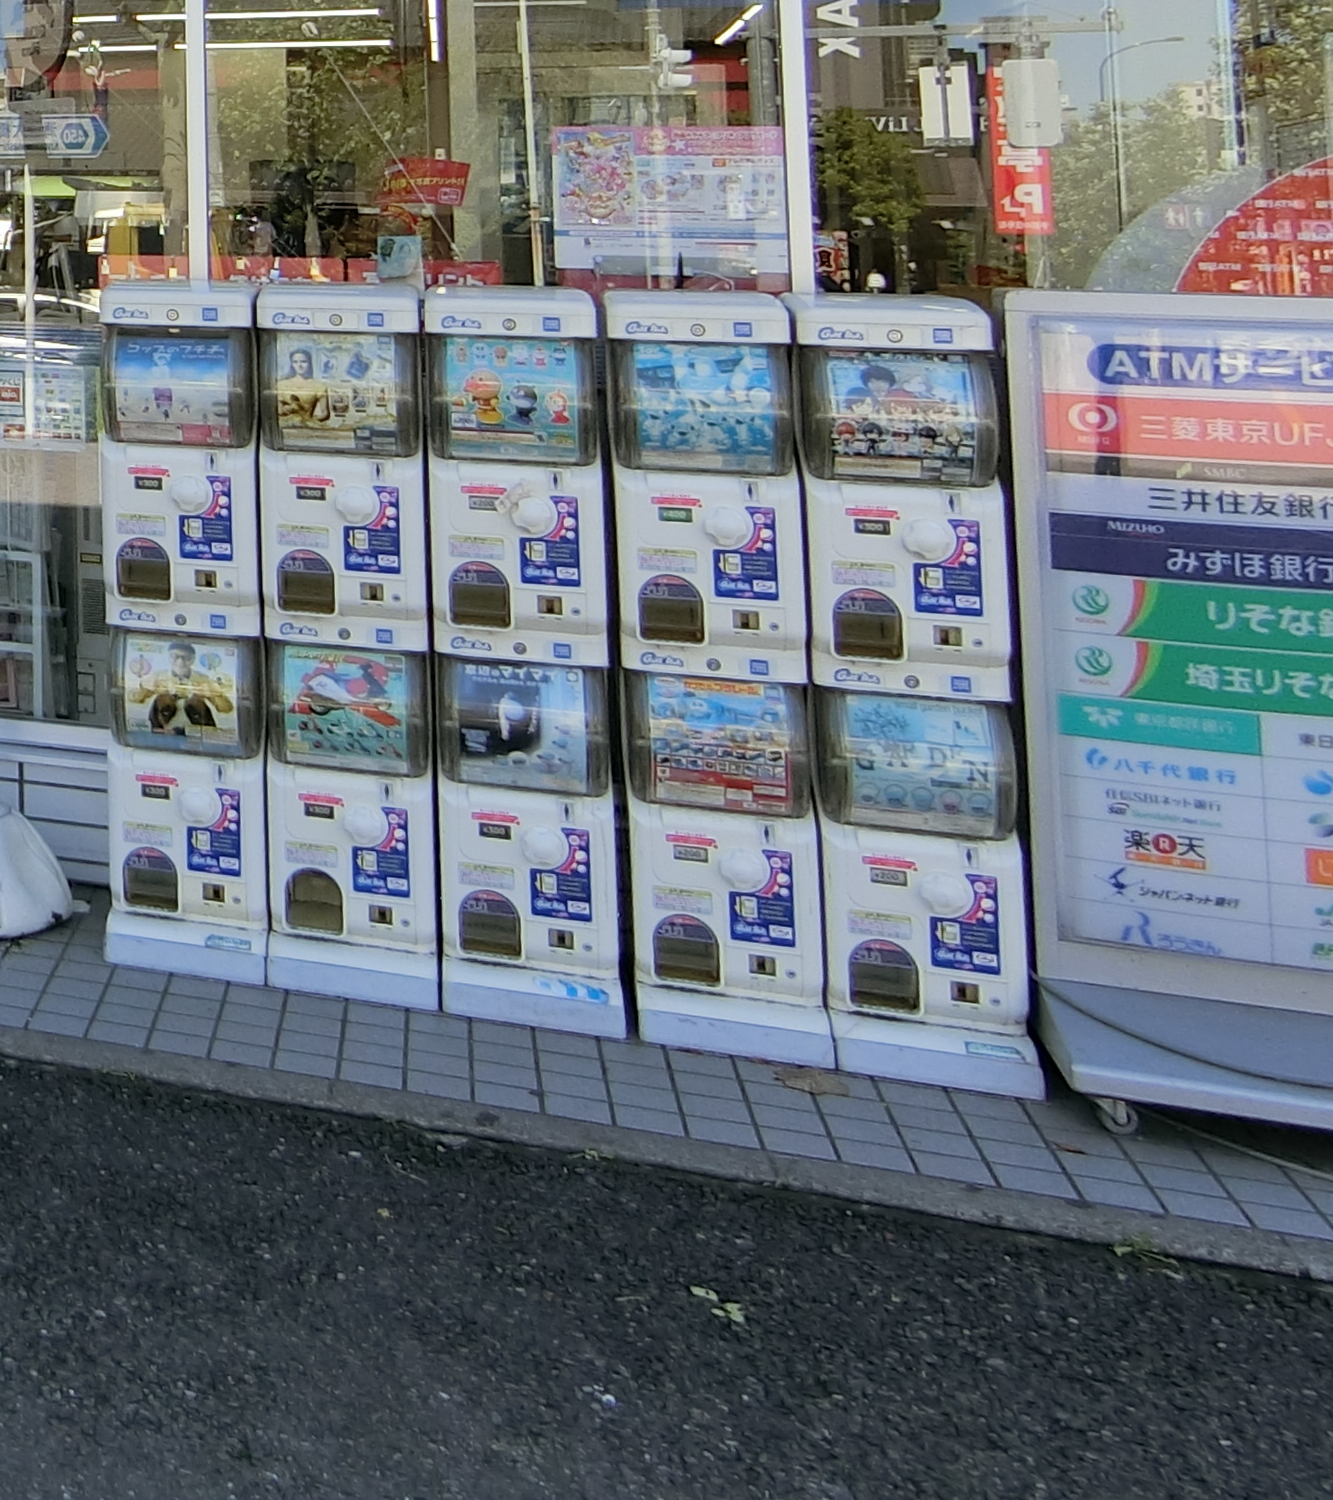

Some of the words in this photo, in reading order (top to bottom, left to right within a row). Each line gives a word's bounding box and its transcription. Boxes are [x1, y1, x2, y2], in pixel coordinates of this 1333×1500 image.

[126, 343, 226, 356] コップのフチ子
[1202, 466, 1246, 480] SMBC
[1106, 519, 1165, 536] MIZUHO
[1165, 548, 1333, 583] みずほ銀行
[1114, 758, 1237, 785] 八千代銀行
